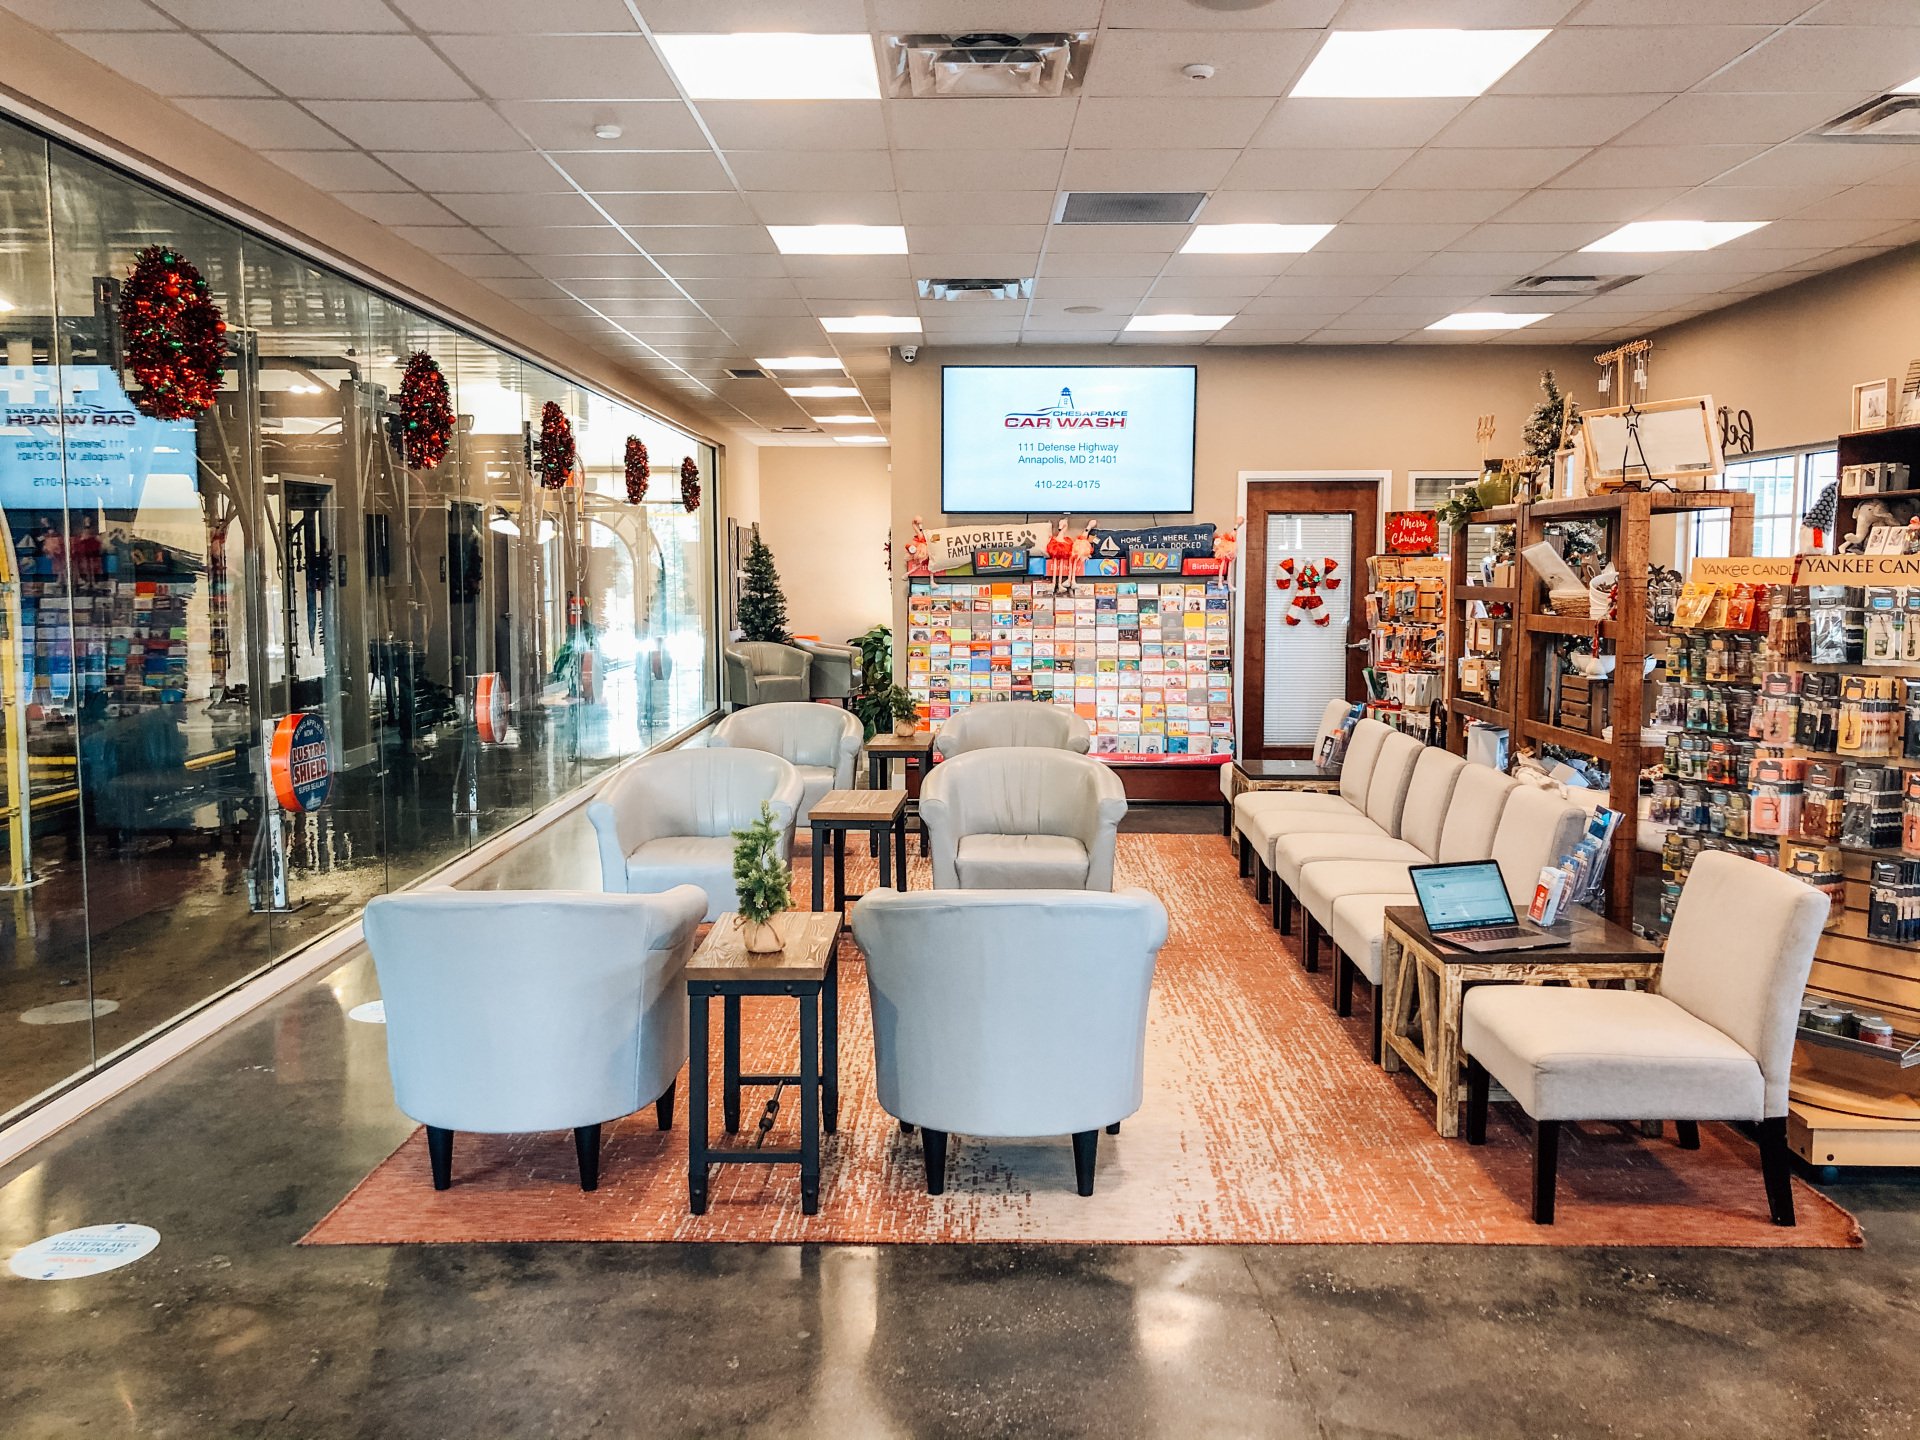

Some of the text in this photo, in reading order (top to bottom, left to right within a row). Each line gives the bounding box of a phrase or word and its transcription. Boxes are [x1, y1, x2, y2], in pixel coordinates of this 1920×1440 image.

[1004, 417, 1126, 428] CAR WASH
[1018, 443, 1119, 453] 111 Defense Highway
[1018, 455, 1117, 465] Annapolis, MD 21401
[1034, 480, 1101, 489] 410-224-0175
[1400, 518, 1427, 531] Merry
[946, 530, 1014, 547] FAVORITE
[1120, 536, 1141, 544] HOME
[1163, 534, 1188, 542] WHERE
[1194, 533, 1208, 541] THE
[1391, 531, 1433, 545] Christmas
[1170, 542, 1201, 550] DOCKED
[979, 552, 1021, 566] RSVP
[1133, 553, 1177, 567] RSVP
[1752, 564, 1794, 576] CANDL
[1805, 559, 1920, 574] YANKEE CAN
[292, 741, 327, 763] LUSTRA
[294, 758, 328, 787] SHIELD
[298, 783, 310, 794] SUPER
